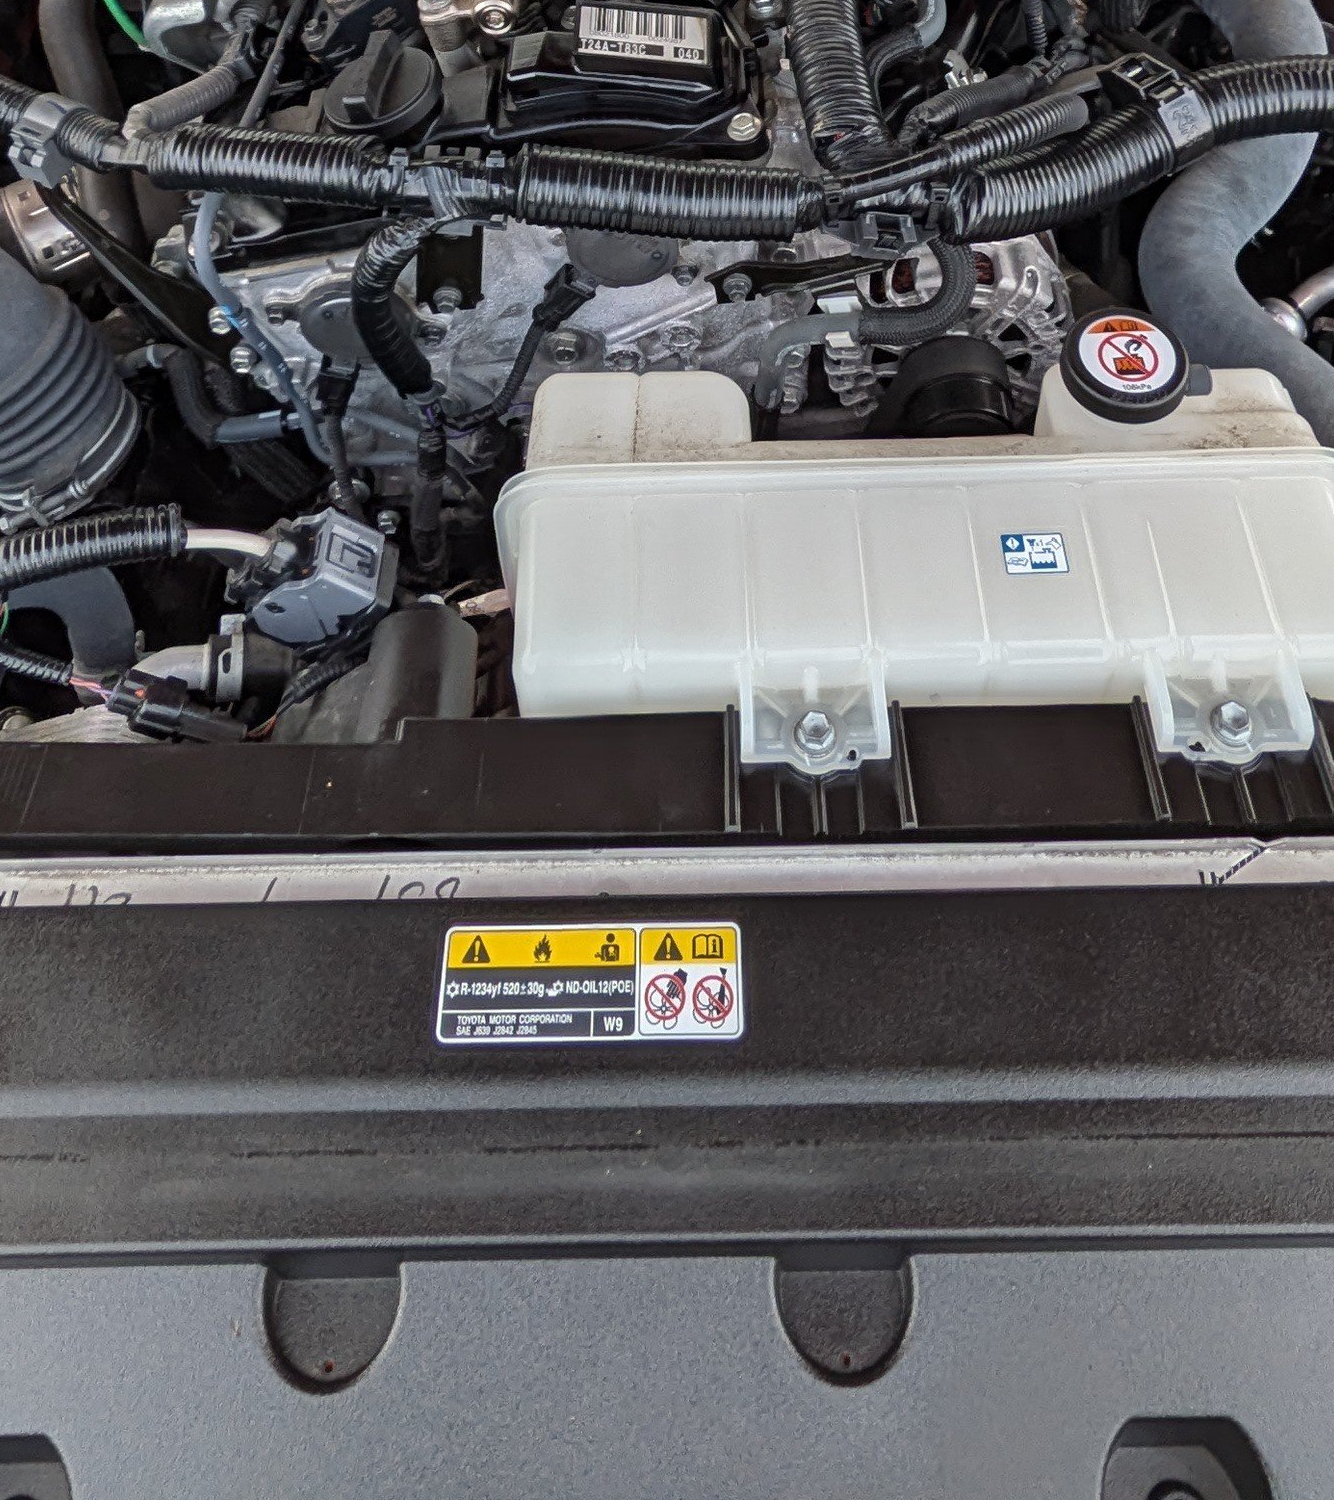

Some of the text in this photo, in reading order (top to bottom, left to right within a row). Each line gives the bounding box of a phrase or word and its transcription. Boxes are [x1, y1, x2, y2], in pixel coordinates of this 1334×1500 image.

[677, 48, 699, 60] 040
[461, 982, 501, 999] R-1234yf
[566, 980, 634, 996] ND-OIL12(POE)
[457, 1014, 572, 1025] TOYOTA MOTOR CORPORATION
[603, 1016, 623, 1032] W9
[456, 1026, 471, 1035] SAE
